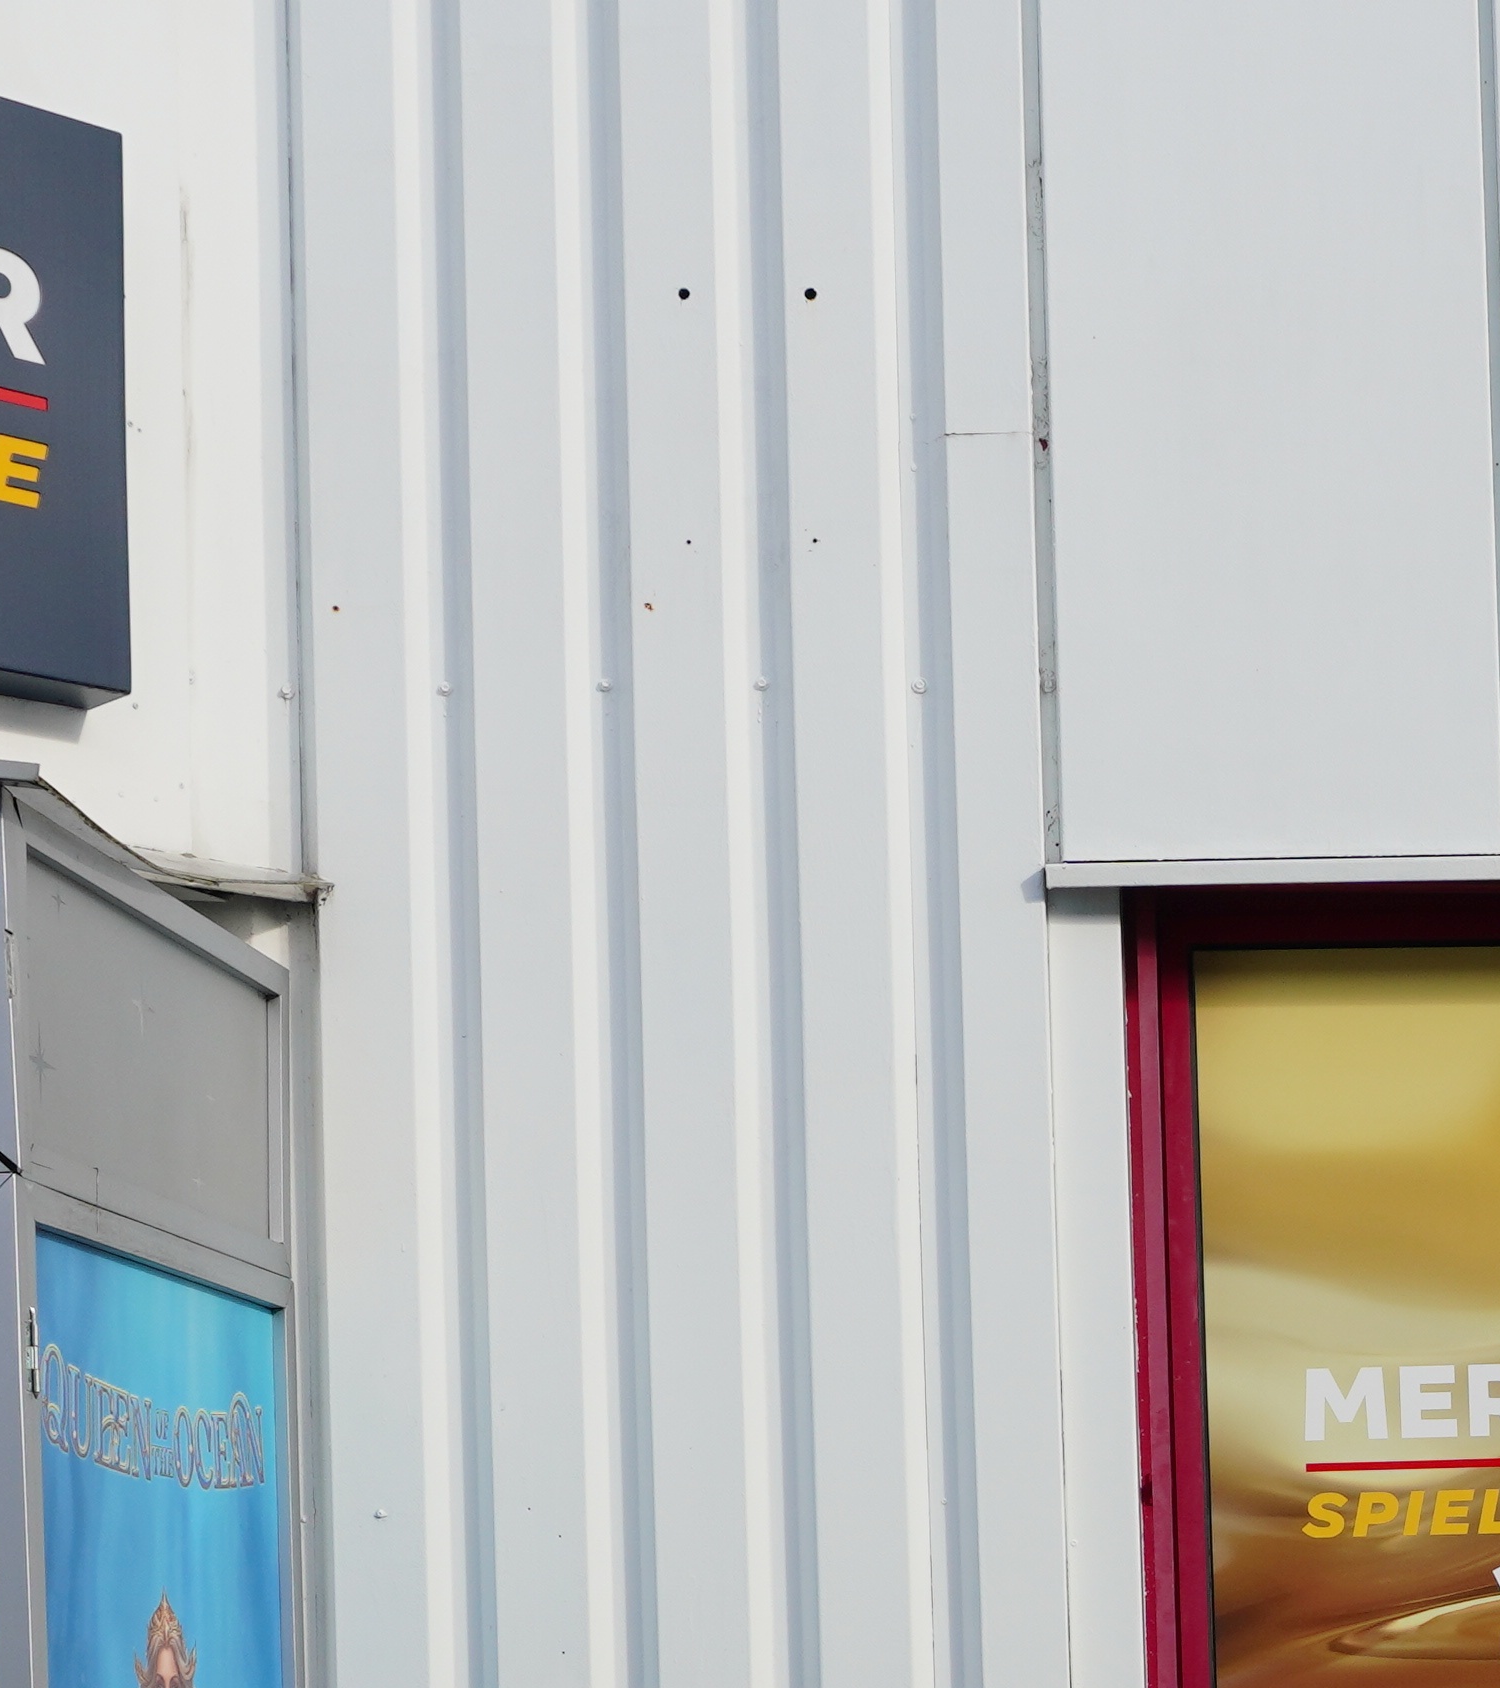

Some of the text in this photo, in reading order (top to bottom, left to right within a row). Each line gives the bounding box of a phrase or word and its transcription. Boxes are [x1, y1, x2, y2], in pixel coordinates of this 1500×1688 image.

[40, 1343, 153, 1482] QUEEN
[155, 1407, 169, 1440] OF
[173, 1391, 265, 1490] OCEAN
